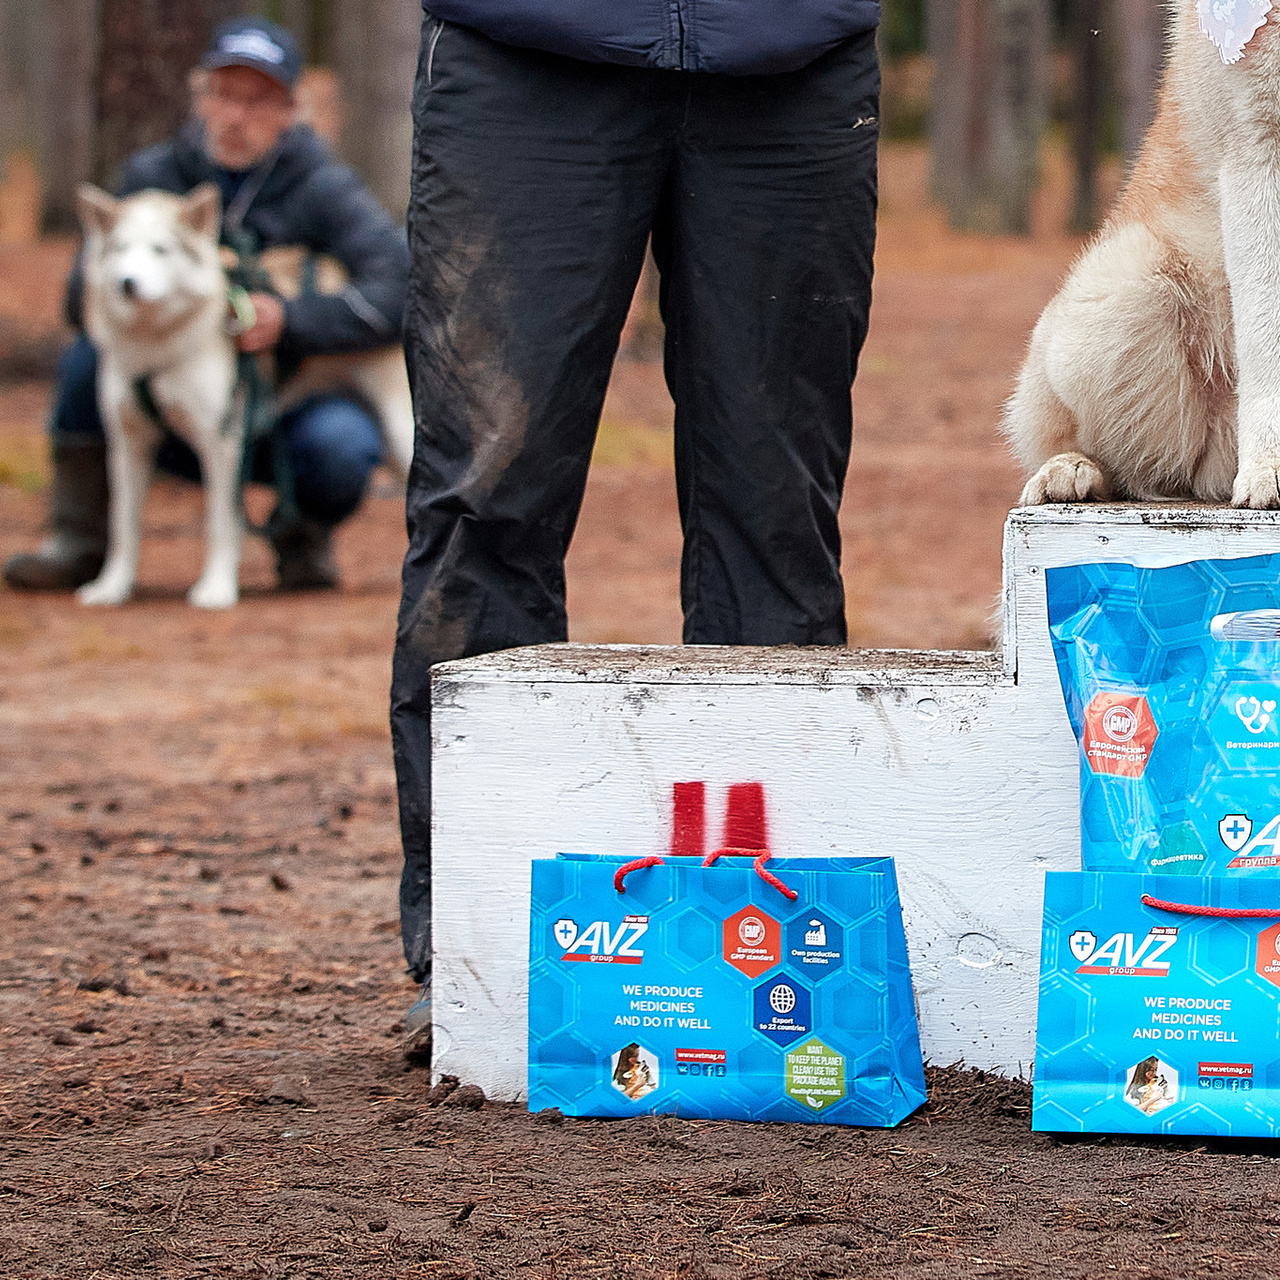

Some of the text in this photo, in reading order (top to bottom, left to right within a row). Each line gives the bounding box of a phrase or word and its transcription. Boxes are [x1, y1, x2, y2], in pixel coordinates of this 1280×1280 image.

[1089, 740, 1146, 754] Европейский
[1087, 748, 1148, 762] стандарт GMP
[1151, 852, 1204, 867] Фармацевтика
[1239, 857, 1277, 868] группа
[567, 921, 649, 957] AVZ
[806, 951, 840, 959] production
[1083, 933, 1178, 969] AVZ
[1109, 967, 1136, 975] group
[622, 985, 704, 998] WE PRODUCE
[630, 1001, 695, 1013] MEDICINES
[1144, 997, 1232, 1010] WE PRODUCE
[614, 1015, 711, 1029] AND DO IT WELL
[1151, 1013, 1222, 1026] MEDICINES
[777, 1024, 806, 1032] countries
[1133, 1028, 1239, 1042] AND DO IT WELL
[1200, 1065, 1252, 1075] www.vetmag.ru
